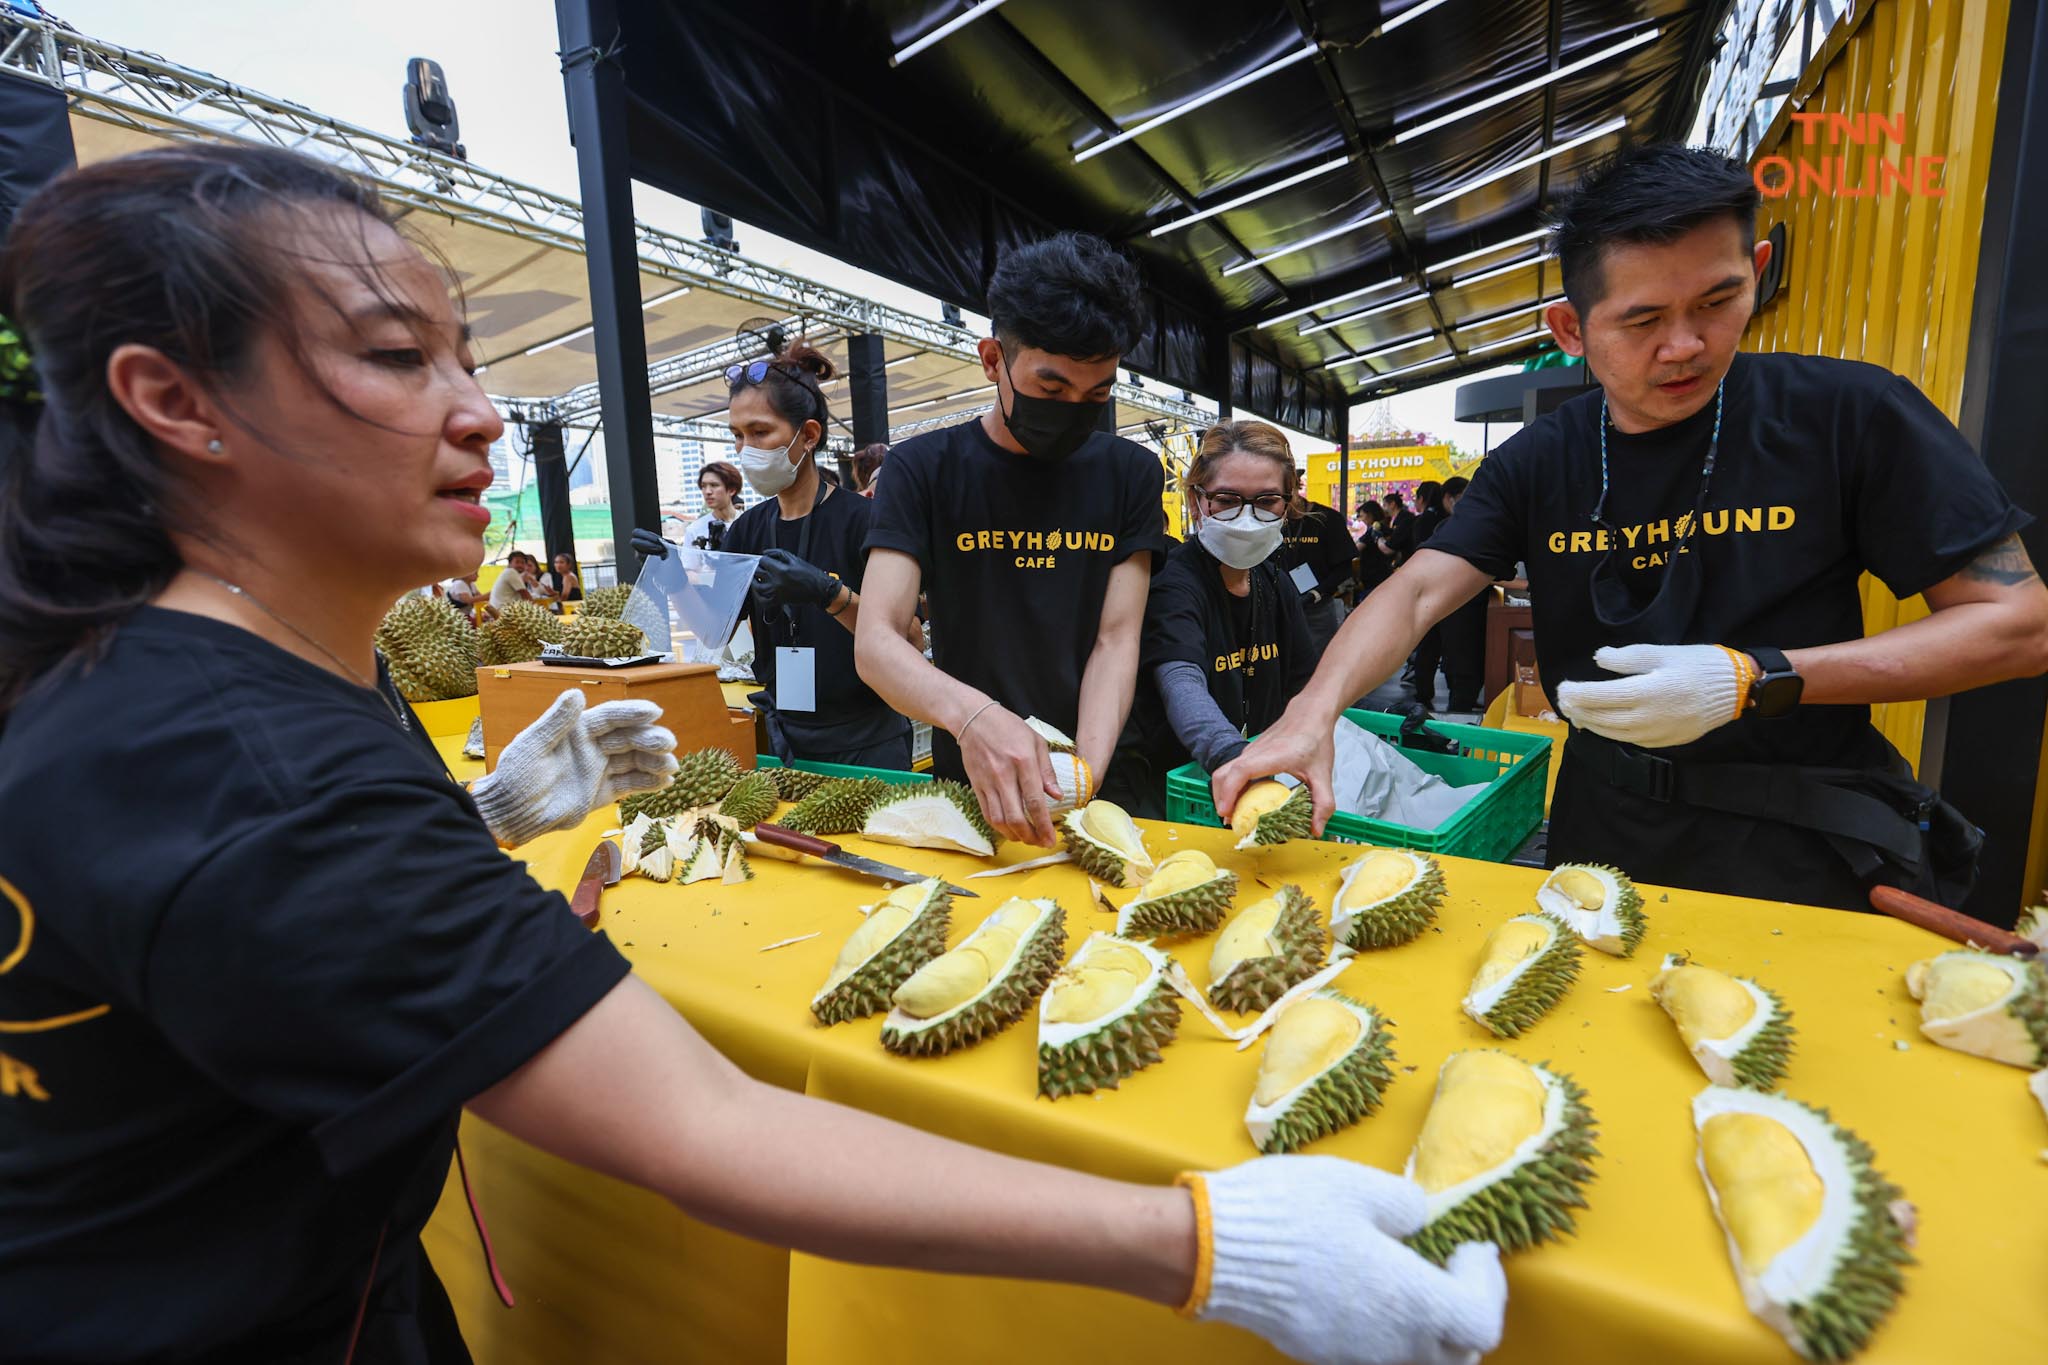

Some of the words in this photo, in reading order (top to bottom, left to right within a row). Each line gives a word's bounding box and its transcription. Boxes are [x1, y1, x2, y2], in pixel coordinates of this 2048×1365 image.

[1361, 470, 1385, 479] CAFÉ
[956, 528, 1115, 552] GREYHOUND
[1548, 505, 1796, 553] GREYHOUND
[1015, 554, 1056, 568] CAFÉ
[1632, 545, 1690, 570] CA
